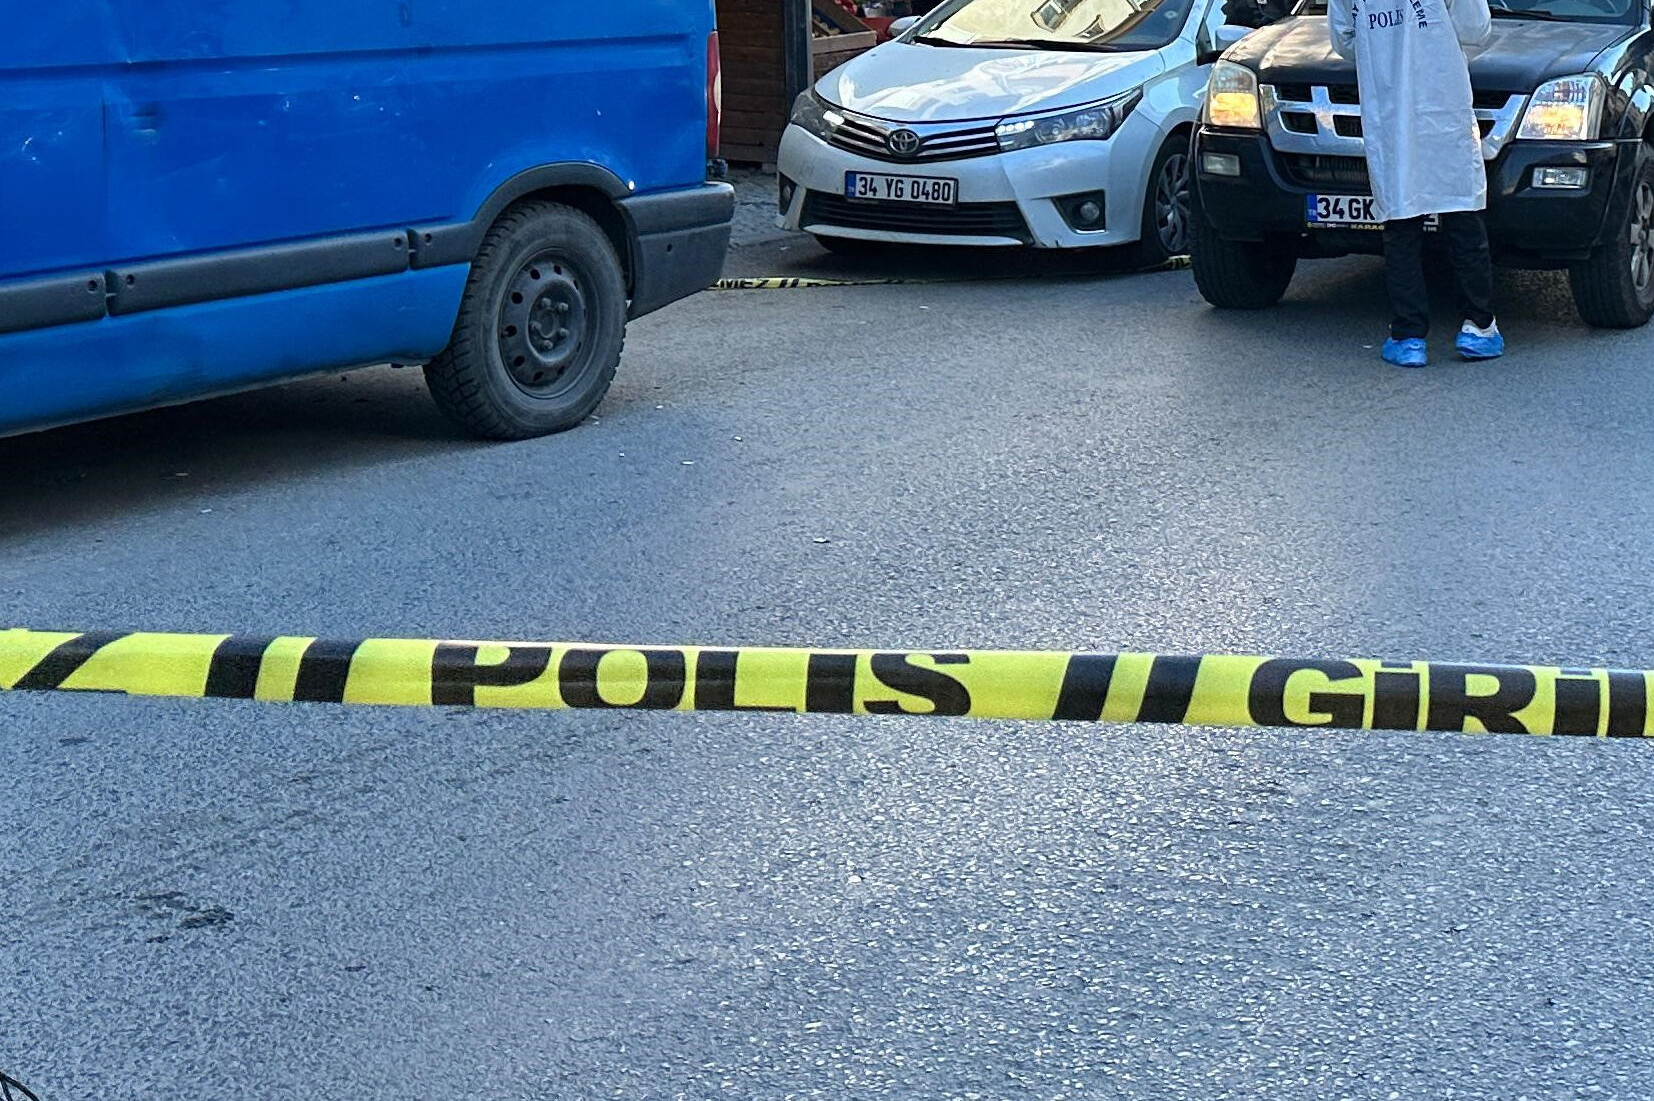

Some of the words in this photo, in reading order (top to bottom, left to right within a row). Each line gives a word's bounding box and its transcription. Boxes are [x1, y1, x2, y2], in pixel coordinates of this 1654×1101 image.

[859, 176, 878, 197] 34
[885, 178, 905, 199] YG
[910, 180, 952, 202] 0480
[1317, 197, 1345, 219] 34
[1348, 198, 1376, 221] GK
